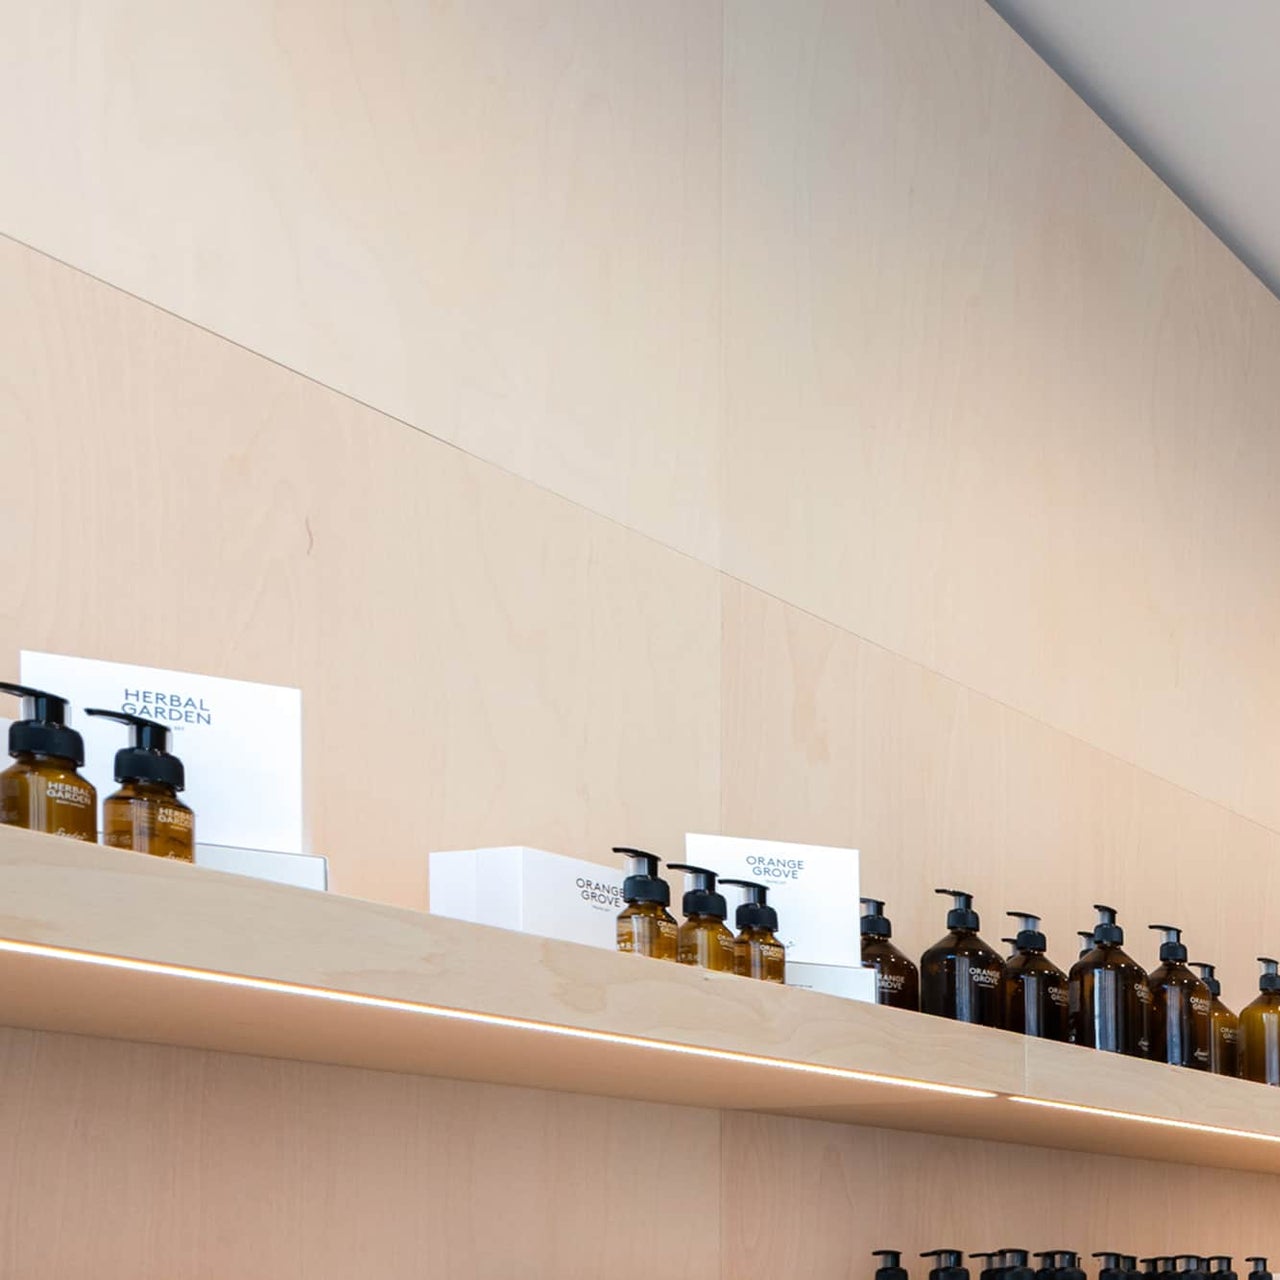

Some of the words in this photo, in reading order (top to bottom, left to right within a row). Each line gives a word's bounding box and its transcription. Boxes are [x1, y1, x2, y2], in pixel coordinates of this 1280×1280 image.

[124, 688, 211, 711] HERBAL
[121, 703, 211, 725] GARDEN
[46, 789, 91, 805] GARDEN
[746, 855, 805, 870] ORANGE
[752, 866, 799, 880] GROVE
[575, 877, 625, 899] ORANGE
[581, 890, 621, 908] GROVE
